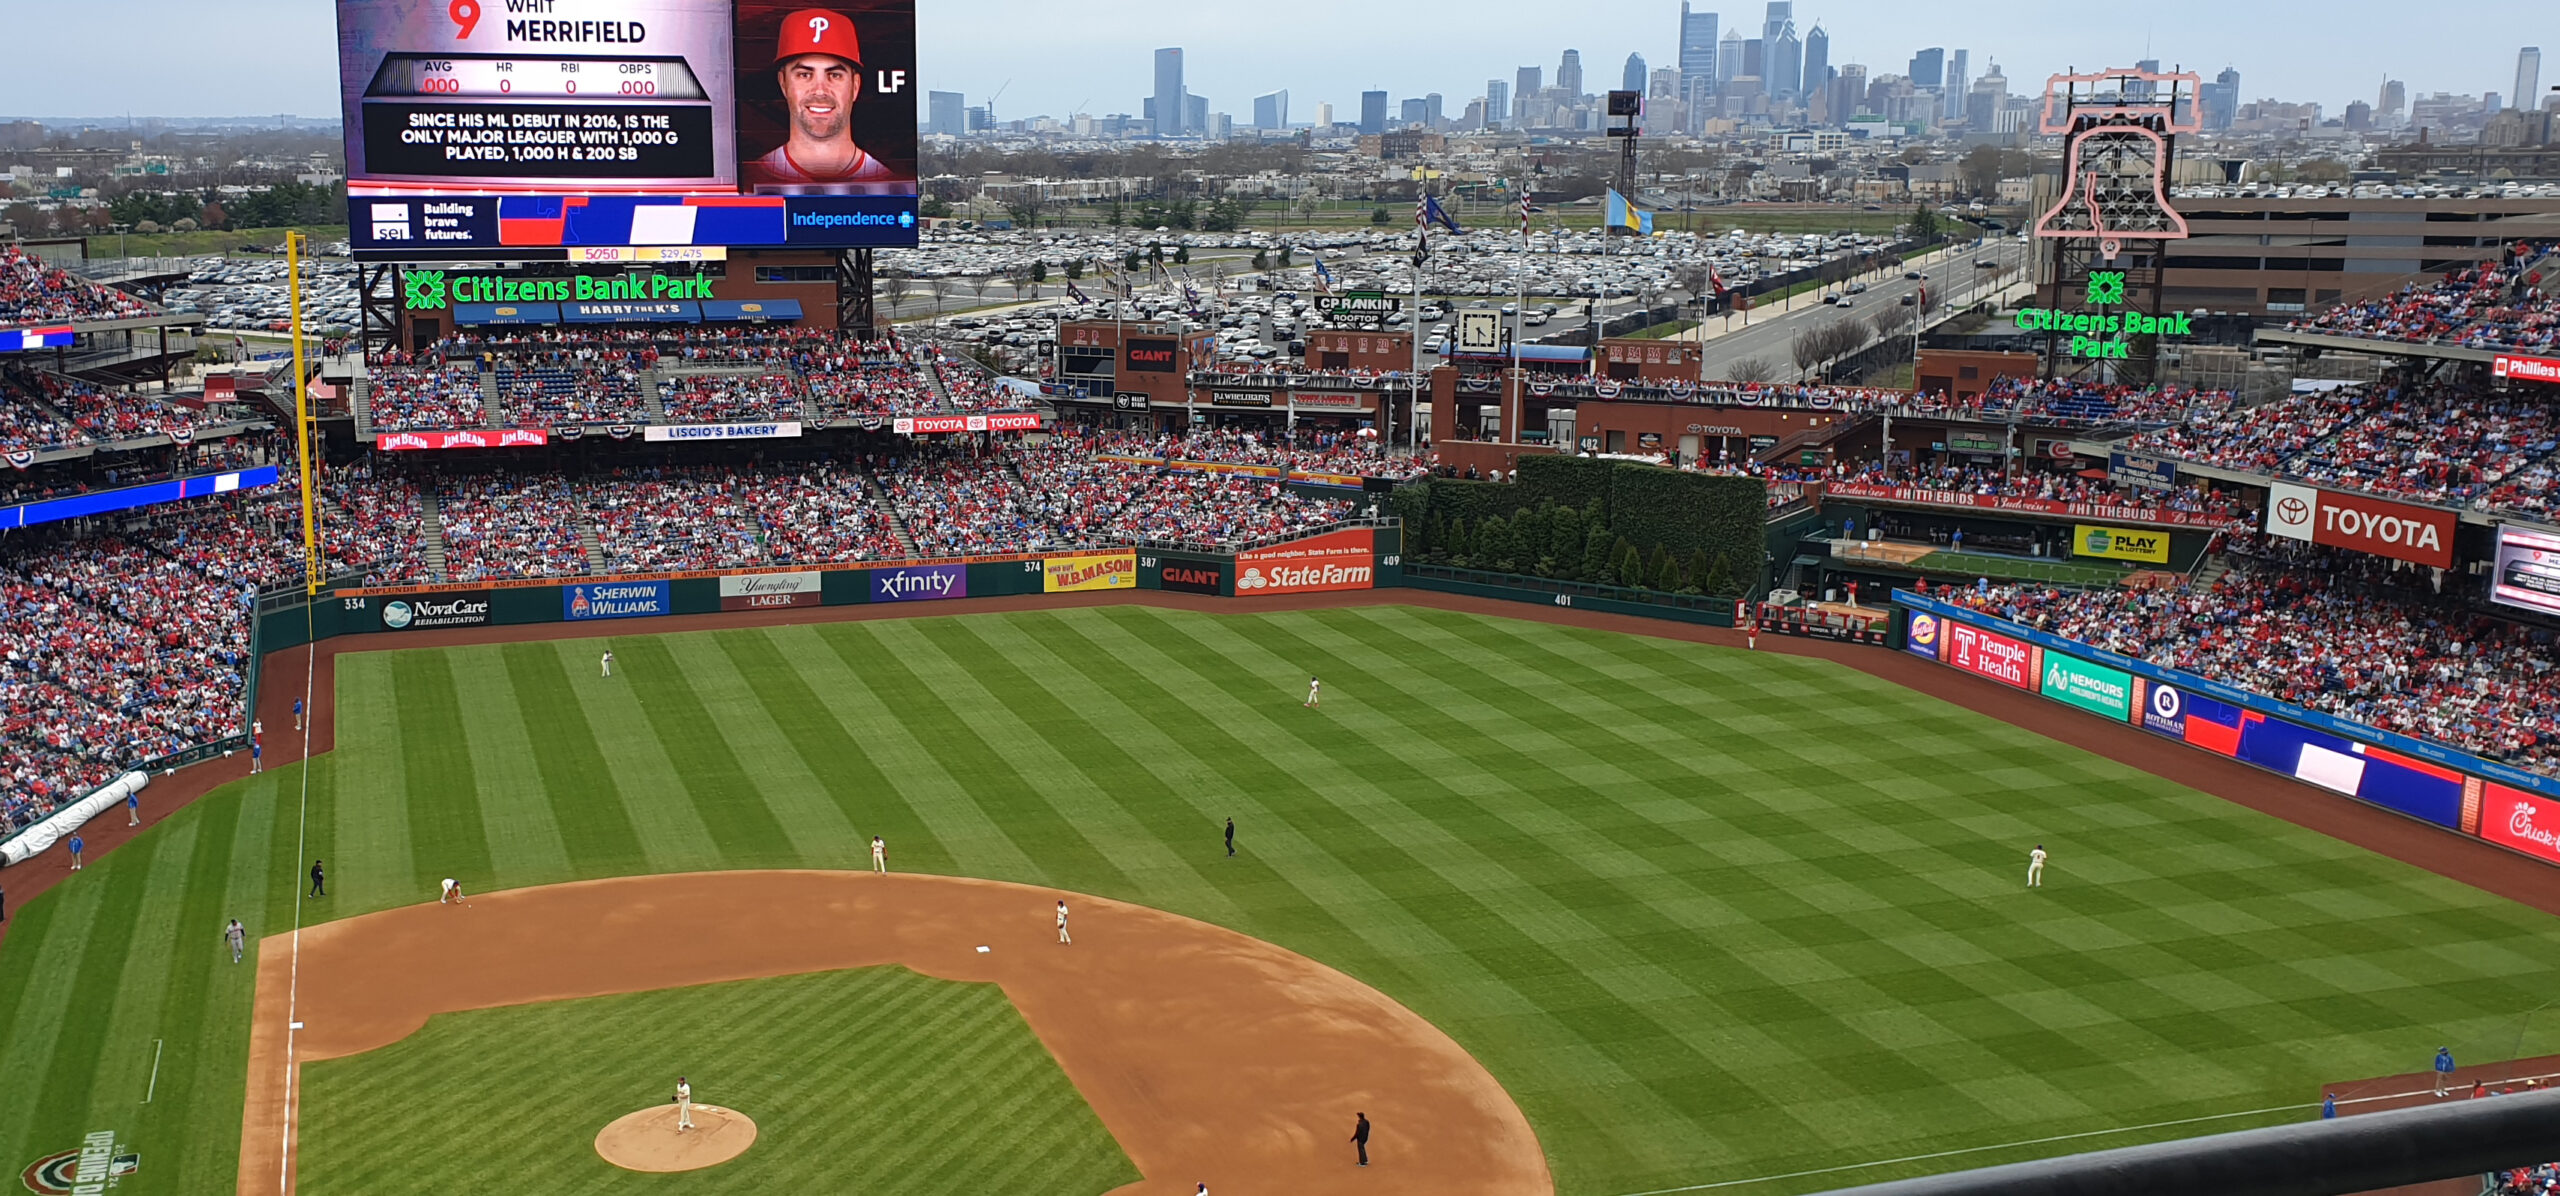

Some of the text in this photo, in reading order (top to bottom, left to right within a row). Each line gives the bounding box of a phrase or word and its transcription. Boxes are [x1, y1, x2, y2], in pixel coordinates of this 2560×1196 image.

[507, 0, 552, 13] WHIT
[448, 0, 481, 40] 9
[507, 20, 646, 43] MERRIFIELD
[809, 17, 829, 43] P
[424, 61, 652, 74] AVG HR RBI OBPS
[420, 78, 655, 95] .000 0 0 .000
[878, 70, 905, 93] LF
[409, 114, 670, 130] SINCE HIS ML DEBUT IN 2016, IS THE
[401, 130, 678, 146] ONLY MAJOR LEAGUER WITH 1,000 G
[446, 147, 638, 162] PLAYED, 1,000 H & 200 SB
[424, 204, 474, 216] Building
[424, 216, 458, 228] brave
[793, 212, 895, 228] Independence
[661, 249, 702, 260] $29,475
[452, 272, 714, 302] Citizens Bank Park
[580, 305, 632, 314] HARRY
[655, 304, 680, 314] K'S
[1320, 298, 1392, 310] CP RANKIN
[1333, 314, 1378, 322] ROOFTOP
[2016, 308, 2192, 334] Citizens Bank
[2072, 336, 2128, 358] Park
[1130, 350, 1172, 362] GIANT
[2510, 360, 2556, 376] Phillies
[916, 419, 964, 431] TOYOTA
[989, 416, 1037, 428] TOYOTA
[499, 430, 543, 446] JIM BEAM
[669, 424, 778, 439] LISCIO'S BAKERY
[1702, 426, 1742, 435] TOYOTA
[383, 433, 428, 450] JIM BEAM
[441, 431, 486, 448] JIM BEAM
[1830, 483, 1886, 498] Budweiser
[1992, 496, 2051, 512] Budweiser
[2322, 505, 2440, 552] TOYOTA
[2115, 536, 2158, 549] PLAY
[1260, 552, 1276, 560] good
[1277, 550, 1307, 558] neighbor,
[2124, 547, 2156, 555] LOTTERY
[1024, 562, 1040, 573] 374
[1141, 557, 1156, 568] 387
[1383, 555, 1400, 566] 409
[362, 549, 1129, 596] ASPLUNDH ASPLUNDH ASPLUNDH ASPLUNDH ASPLUNDH ASPLUNDH ASPLUNDH ASPLUNDH ASPLUNDH ASPLUNDH ASPLUNDH ASPLUNDH ASPLUNDH
[1162, 567, 1220, 586] GIANT
[739, 576, 802, 594] Yuengling
[881, 570, 956, 598] xfinity
[592, 585, 657, 600] SHERWIN
[750, 594, 792, 606] LAGER
[1555, 594, 1571, 606] 401
[344, 598, 366, 610] 334
[413, 600, 488, 618] NovaCare
[414, 616, 486, 626] REHABILITATION
[1980, 634, 2026, 663] Temple
[1978, 654, 2021, 682] Health
[2070, 672, 2124, 698] NEMOURS
[2162, 695, 2172, 708] R
[2146, 712, 2184, 731] ROTHMAN
[2333, 720, 2376, 738] Independence
[2418, 745, 2446, 759] ibx.com
[2482, 763, 2529, 784] Independence
[76, 1130, 114, 1183] OPENING
